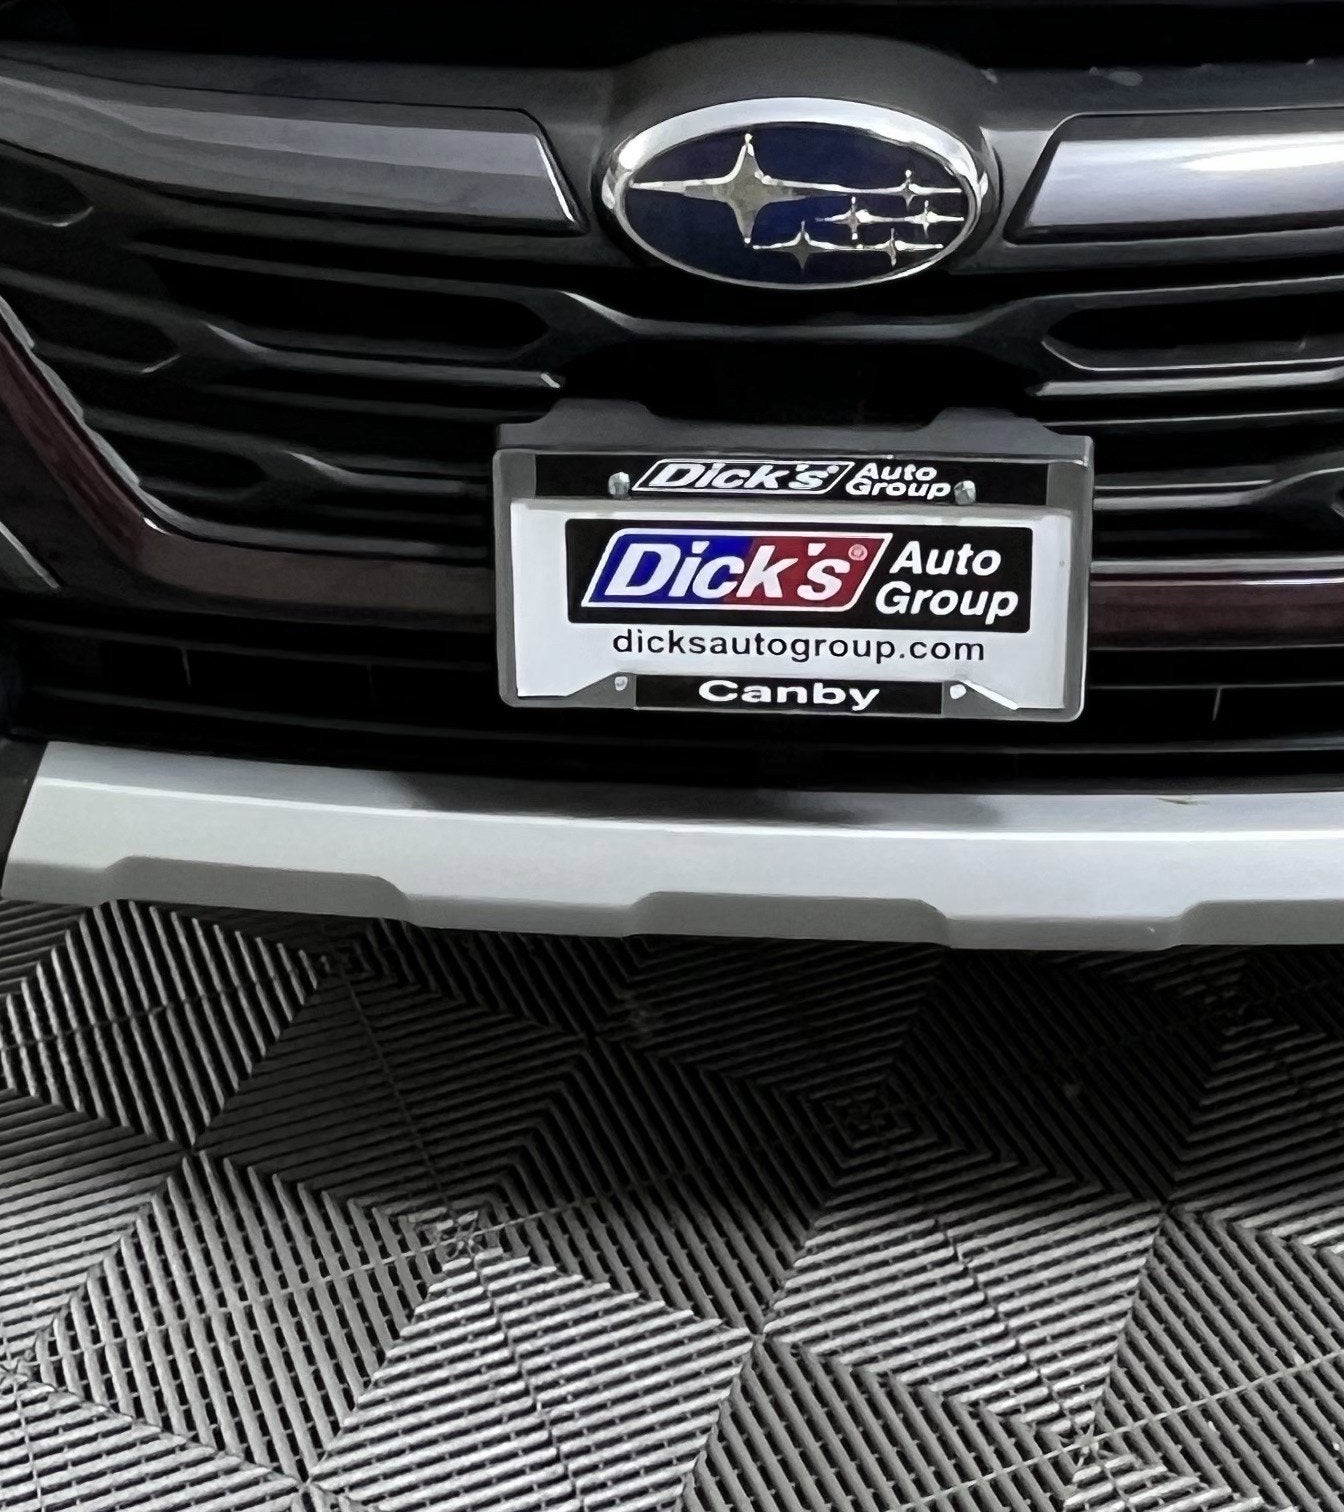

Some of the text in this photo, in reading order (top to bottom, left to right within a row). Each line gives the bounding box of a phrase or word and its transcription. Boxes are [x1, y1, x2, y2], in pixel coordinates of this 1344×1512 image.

[648, 462, 828, 489] Dick's
[855, 462, 938, 481] Auto
[845, 478, 951, 500] Group
[604, 540, 849, 602] Dick's
[889, 540, 1001, 577] Auto
[875, 581, 1018, 625] Group
[612, 628, 984, 663] dicksautogroup.com
[698, 679, 880, 711] Canby
